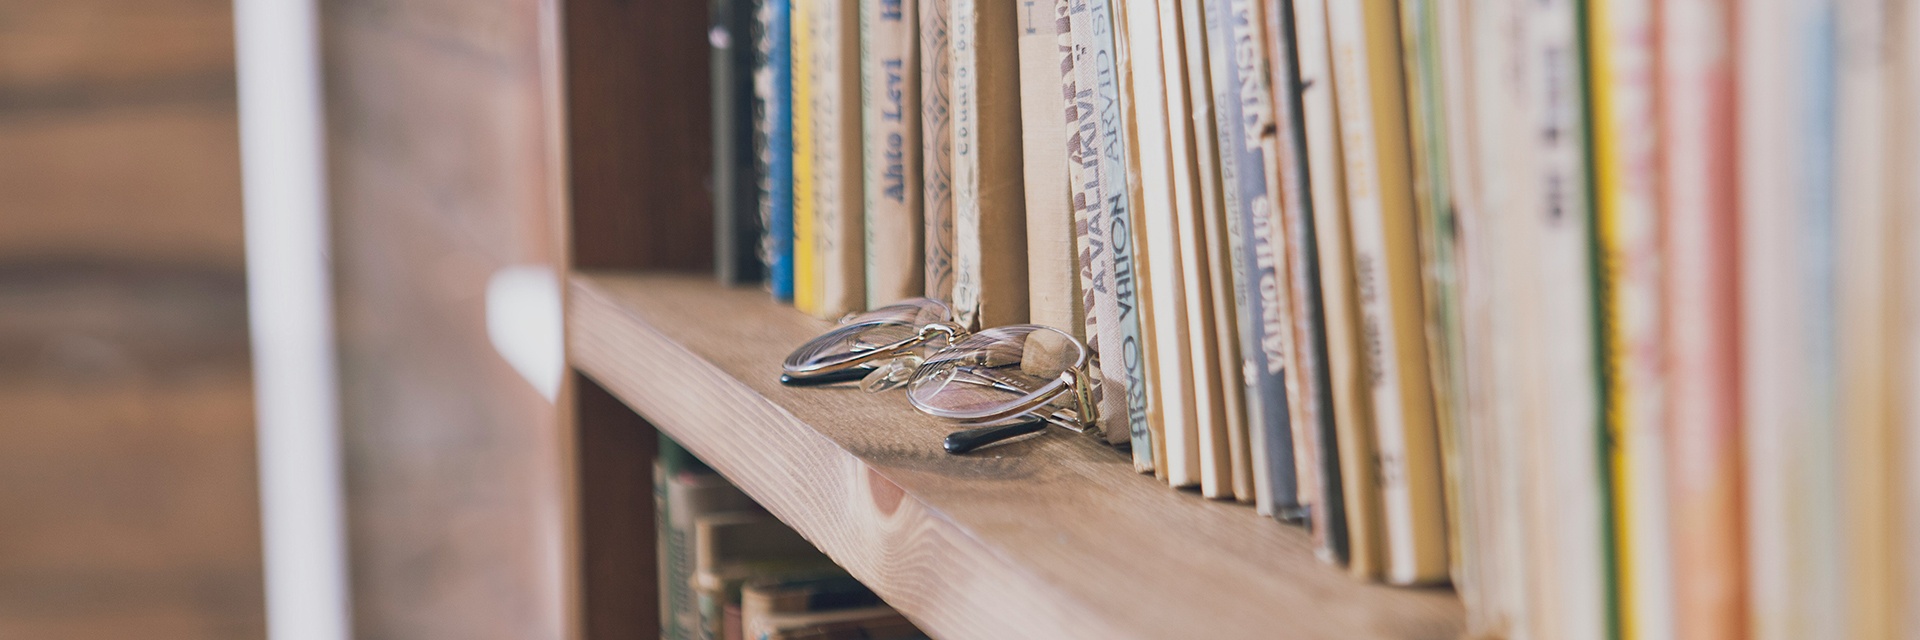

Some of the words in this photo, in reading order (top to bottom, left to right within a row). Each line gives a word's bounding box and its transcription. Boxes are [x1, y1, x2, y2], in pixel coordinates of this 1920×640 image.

[1089, 0, 1107, 36] SI
[880, 58, 903, 123] Levi
[1096, 49, 1119, 164] ARVID
[881, 133, 905, 204] Ahto
[1075, 88, 1107, 294] A.VALLIKIVI
[1108, 193, 1133, 323] VALTON
[1252, 195, 1276, 270] ILUS
[1122, 335, 1147, 440] ARVO
